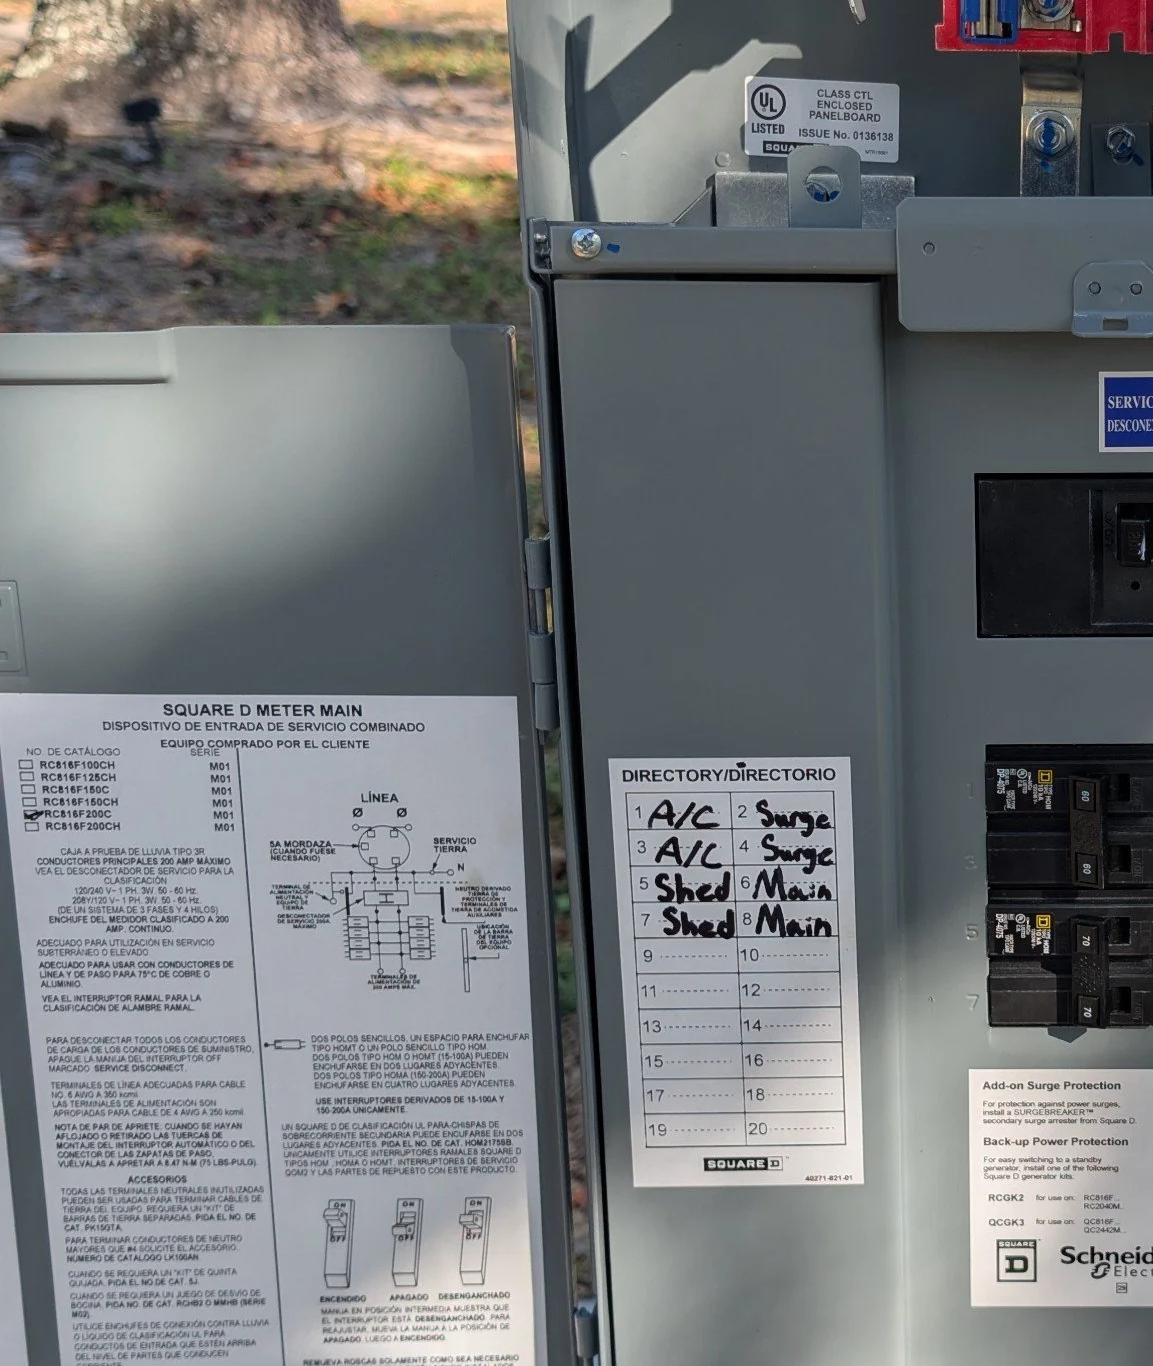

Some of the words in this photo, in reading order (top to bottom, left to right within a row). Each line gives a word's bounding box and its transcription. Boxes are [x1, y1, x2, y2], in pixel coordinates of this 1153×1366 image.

[817, 89, 850, 99] CLASS
[854, 91, 873, 100] CTL
[759, 92, 777, 112] UL
[817, 100, 872, 111] ENCLOSED
[809, 111, 881, 122] PANELBOARD
[752, 123, 785, 134] LISTED
[799, 129, 830, 138] ISSUE
[833, 130, 850, 139] No.
[853, 131, 894, 141] 0136138
[163, 704, 235, 716] SQUARE
[240, 705, 251, 716] D
[257, 705, 315, 717] METER
[320, 705, 363, 717] MAIN
[102, 721, 181, 731] DISPOSITIVO
[185, 722, 202, 731] DE
[205, 722, 264, 732] ENTRADA
[267, 722, 285, 732] DE
[288, 722, 347, 732] SERVICIO
[350, 722, 425, 732] COMBINADO
[161, 739, 204, 749] EQUIPO
[207, 739, 273, 749] COMPRADO
[277, 740, 301, 749] POR
[305, 740, 319, 749] EL
[322, 740, 370, 749] CLIENTE
[47, 748, 62, 756] DE
[64, 746, 121, 756] CATÁLOGO
[40, 761, 116, 770] RC816F100CH
[210, 762, 230, 770] M01
[41, 773, 116, 782] RC816F125CH
[210, 774, 231, 783] M01
[42, 785, 109, 794] RC816F150C
[212, 787, 232, 795] M01
[361, 791, 399, 803] LÍNEA
[1082, 791, 1090, 801] 60
[43, 798, 119, 807] RC816F150CH
[213, 799, 233, 807] M01
[44, 810, 112, 819] RC816F200C
[214, 811, 234, 819] M01
[635, 806, 642, 818] 1
[648, 799, 720, 829] A/C
[738, 805, 747, 818] 2
[756, 799, 831, 837] Surge
[46, 822, 121, 831] RC816F200CH
[214, 823, 235, 832] M01
[270, 840, 282, 848] 5A
[285, 840, 332, 848] MORDAZA
[433, 837, 477, 845] SERVICIO
[739, 840, 749, 852] 4
[270, 847, 308, 855] (CUANDO
[637, 841, 647, 854] 3
[655, 836, 723, 869] A/C
[271, 854, 320, 862] NECESARIO)
[761, 834, 833, 874] Surge
[457, 863, 464, 872] N
[1083, 863, 1091, 875] 60
[639, 877, 649, 890] 5
[655, 871, 730, 904] Shed
[741, 876, 750, 889] 6
[752, 865, 832, 901] Main
[641, 914, 650, 925] 7
[663, 906, 735, 939] Shed
[743, 912, 752, 925] 8
[756, 903, 832, 938] Main
[1082, 936, 1090, 946] 70
[643, 950, 653, 962] 9
[741, 949, 759, 961] 10
[641, 985, 656, 998] 11
[742, 984, 761, 996] 12
[1083, 1008, 1091, 1018] 70
[643, 1020, 661, 1033] 13
[744, 1019, 762, 1032] 14
[645, 1055, 663, 1068] 15
[745, 1054, 764, 1066] 16
[983, 1082, 1024, 1090] Add-on
[1027, 1082, 1060, 1091] Surge
[1064, 1082, 1121, 1090] Protection
[647, 1089, 664, 1102] 17
[747, 1088, 765, 1101] 18
[649, 1124, 667, 1136] 19
[749, 1122, 768, 1135] 20
[984, 1138, 1029, 1147] Back-up
[1033, 1138, 1068, 1146] Power
[1071, 1138, 1129, 1146] Protection
[707, 1159, 765, 1169] SQUARE
[128, 1175, 188, 1184] ACCESORIOS
[988, 1194, 1024, 1202] RCGK2
[320, 1295, 367, 1303] ENCENDIDO
[390, 1294, 429, 1302] APAGADO
